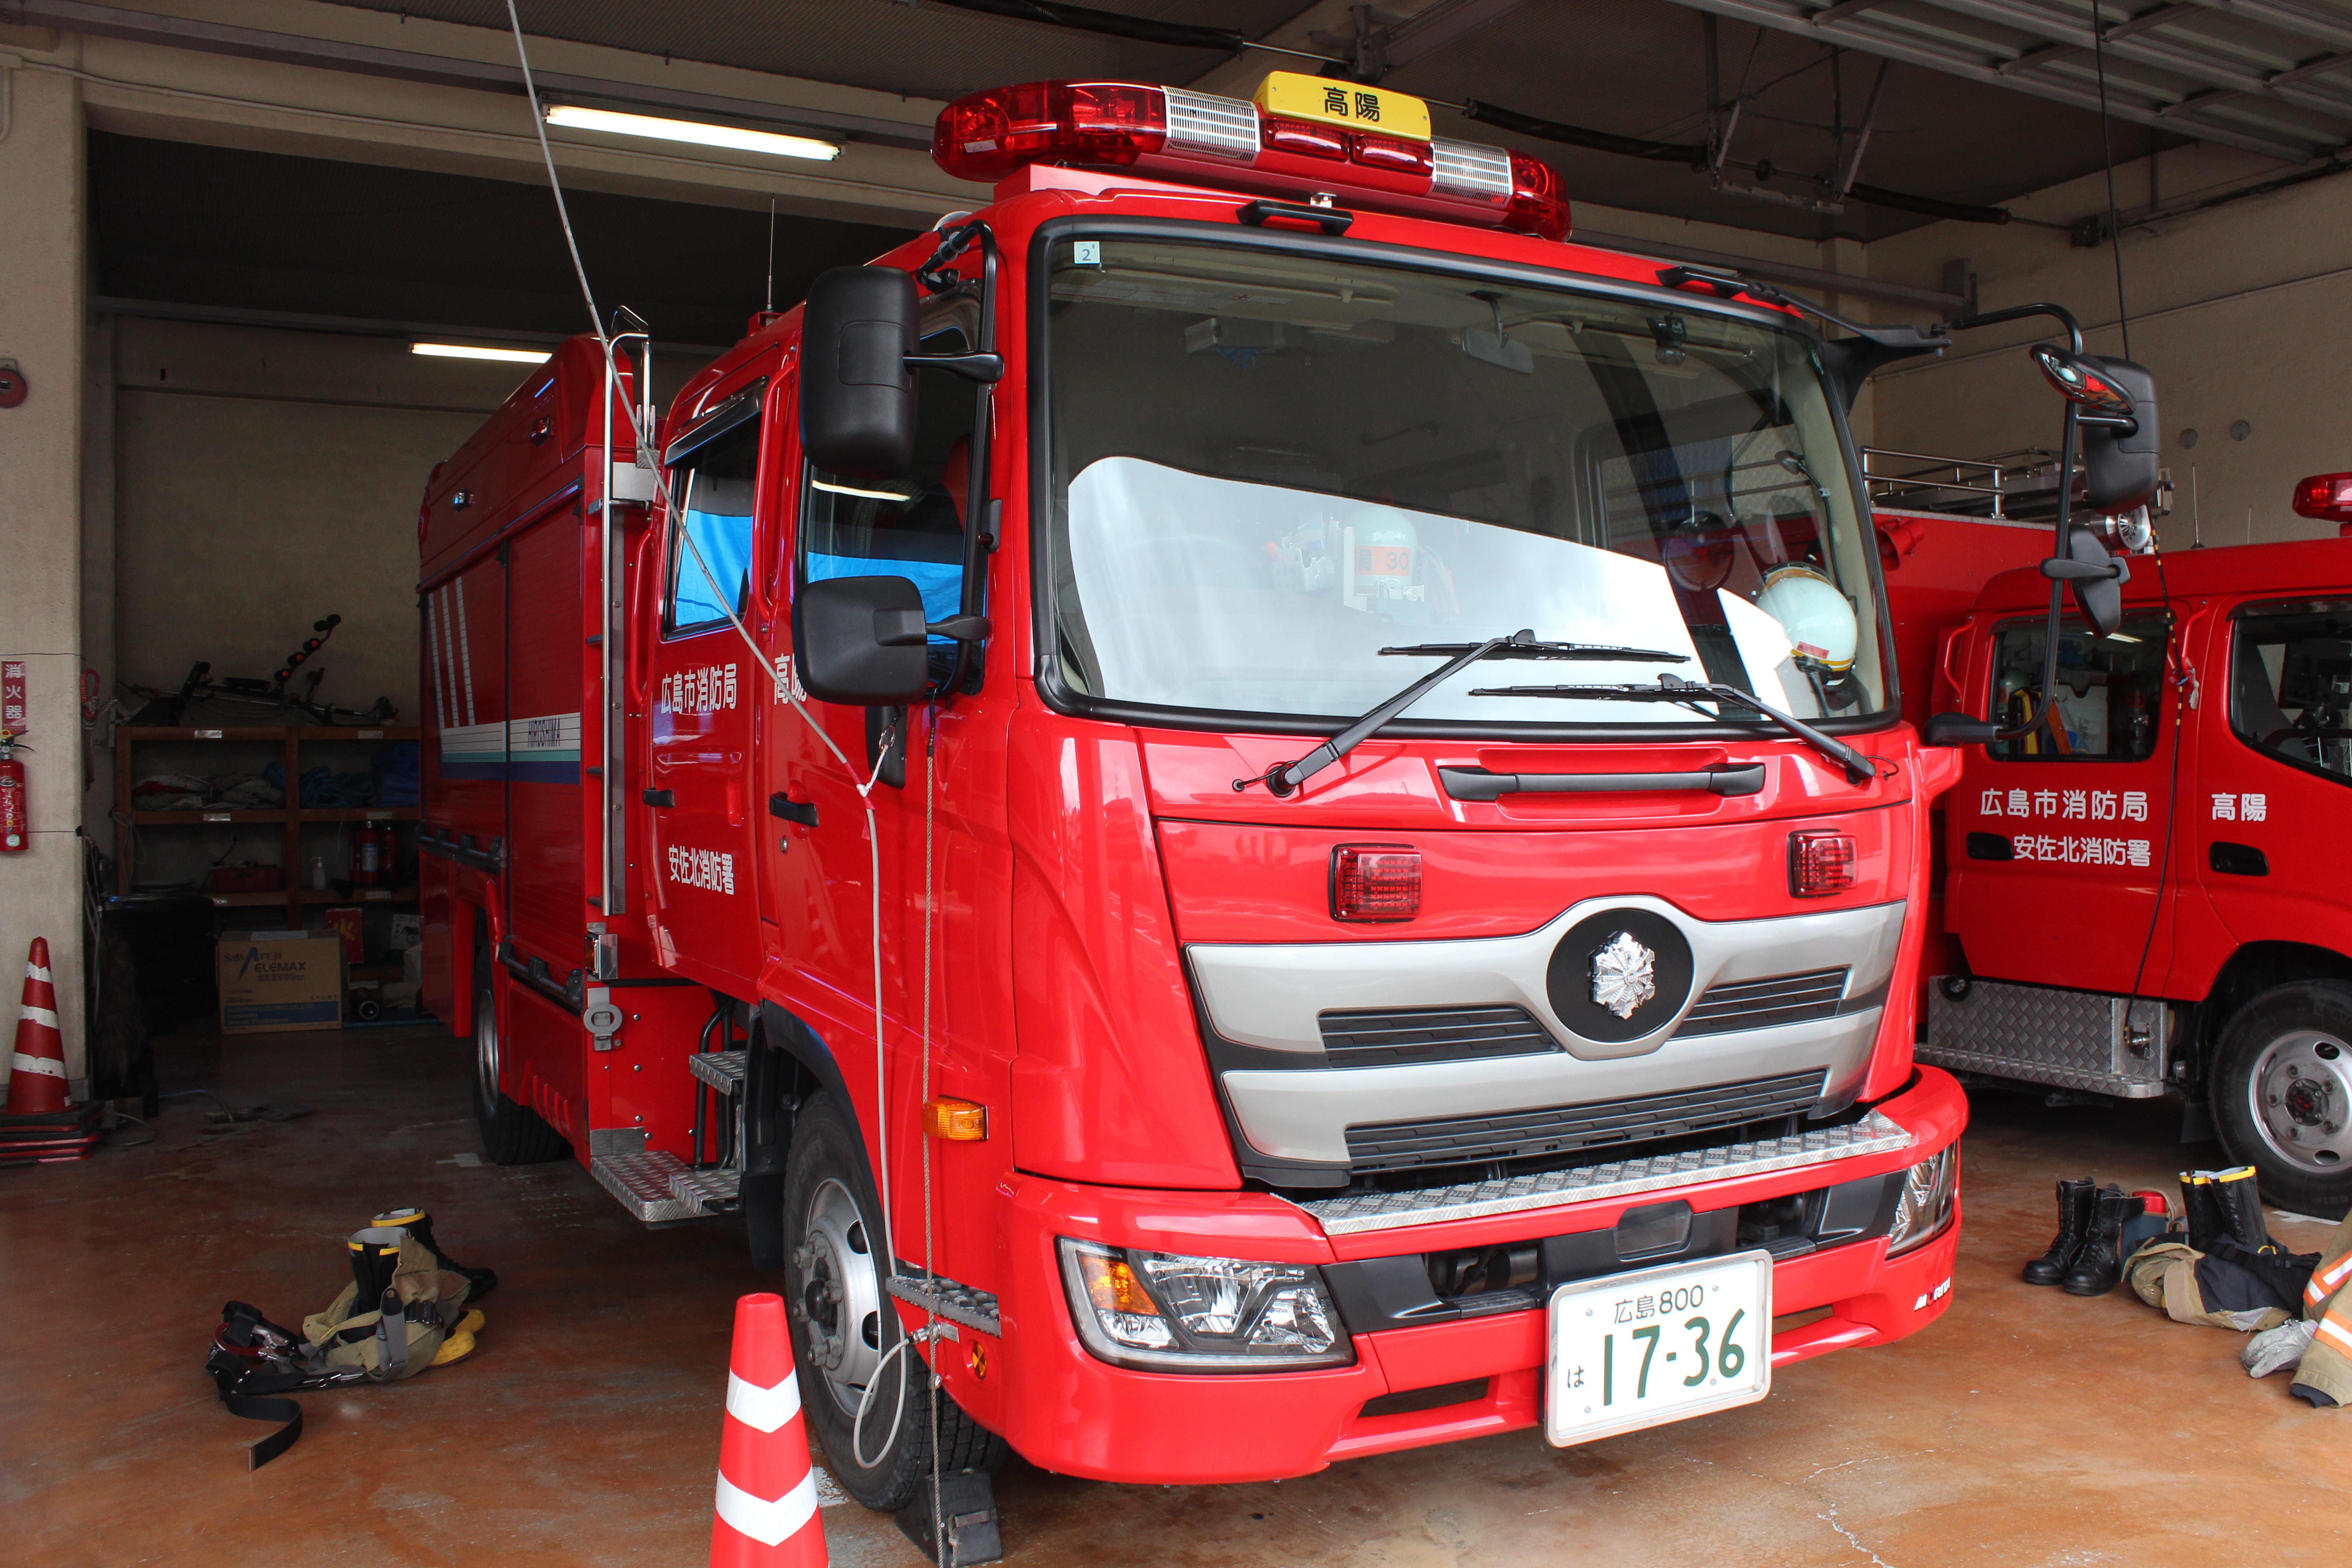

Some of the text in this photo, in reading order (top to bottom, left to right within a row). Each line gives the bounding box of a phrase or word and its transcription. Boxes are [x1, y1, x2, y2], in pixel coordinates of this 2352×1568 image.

[1323, 86, 1380, 123] 高陽
[1082, 249, 1091, 261] 2
[1386, 551, 1409, 570] 30
[5, 664, 22, 720] 消火器
[661, 662, 737, 715] 広島市消防局
[528, 717, 560, 748] HIROSHIMA
[1980, 788, 2148, 822] 広島市消防局
[2211, 792, 2267, 822] 高陽
[2014, 833, 2151, 867] 安佐北消防署
[668, 844, 735, 896] 安佐北消防署
[254, 962, 306, 973] ELEMAX
[1614, 1284, 1704, 1324] 広島 800
[1914, 1276, 1951, 1311] MORITA
[1603, 1308, 1746, 1406] 17-36
[1567, 1366, 1584, 1389] は
